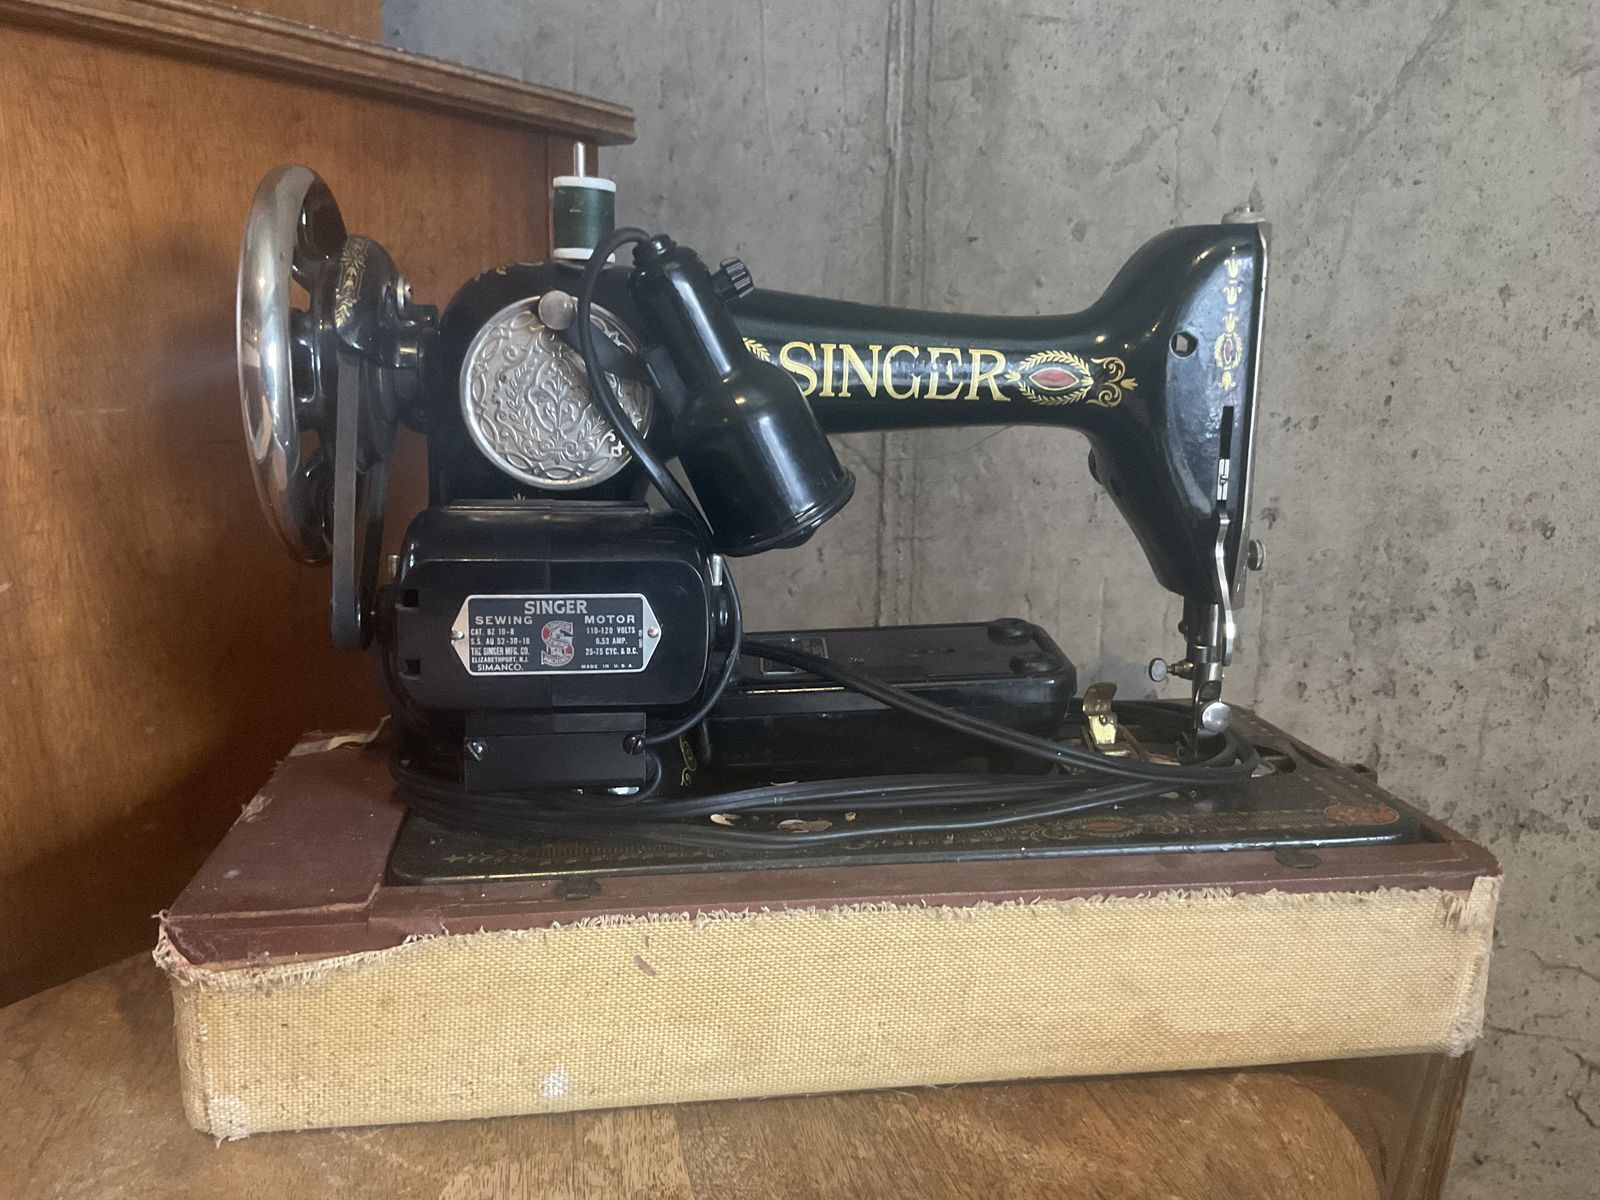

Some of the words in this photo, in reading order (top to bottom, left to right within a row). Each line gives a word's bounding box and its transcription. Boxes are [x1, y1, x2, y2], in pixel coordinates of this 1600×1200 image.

[780, 341, 1011, 402] SINGER
[524, 600, 588, 615] SINGER
[475, 615, 533, 625] SEWING
[584, 614, 635, 624] MOTOR
[586, 626, 613, 634] 110-120
[616, 626, 636, 634] VOLTS
[595, 637, 609, 645] 0.53
[612, 637, 628, 645] AMP.
[470, 646, 482, 656] THE
[483, 646, 504, 656] SINGER
[505, 646, 519, 656] MFG.
[520, 646, 531, 656] CO.
[585, 647, 603, 655] 25-75
[605, 647, 619, 655] CYC.
[620, 647, 626, 655] &
[626, 646, 639, 655] D.C.
[477, 663, 525, 672] SIMANCO.
